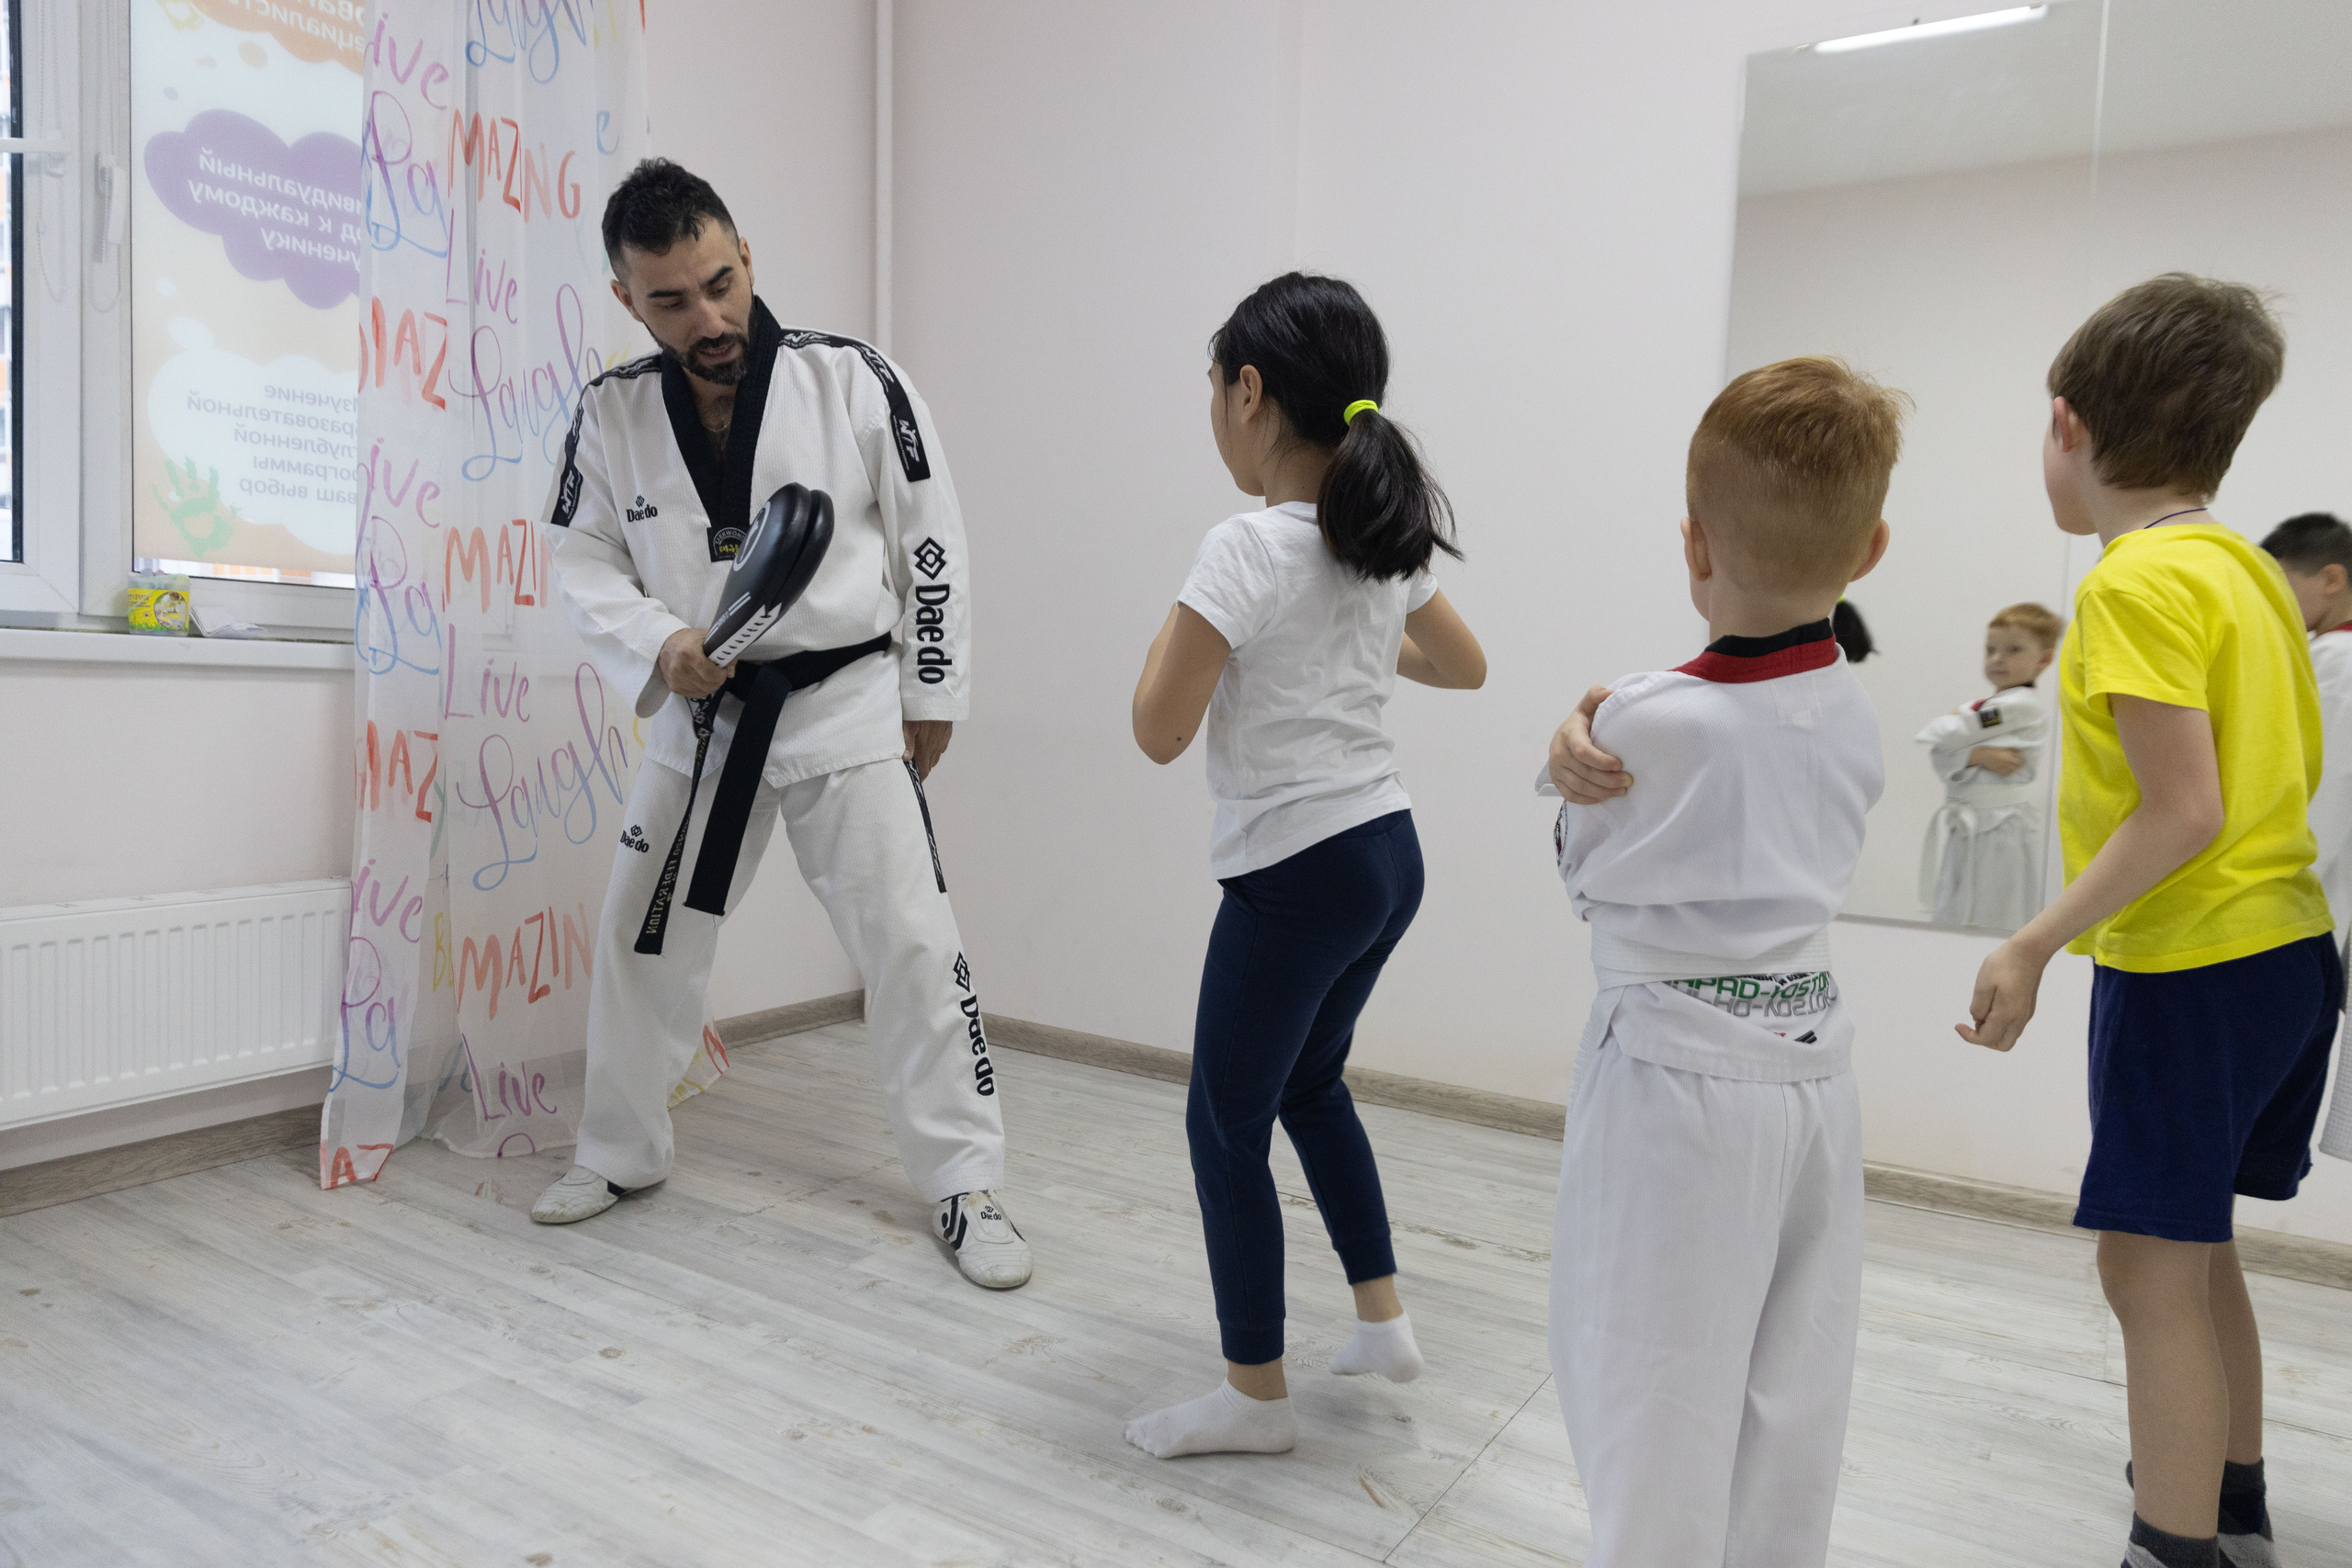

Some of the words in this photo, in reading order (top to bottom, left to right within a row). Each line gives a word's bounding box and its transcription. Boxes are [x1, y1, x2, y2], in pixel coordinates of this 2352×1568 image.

[374, 12, 449, 110] ive
[446, 208, 517, 324] Live
[369, 437, 441, 528] ive
[445, 624, 530, 723] Live
[457, 661, 628, 891] Laugh
[355, 859, 423, 943] ive
[462, 1033, 557, 1122] Live
